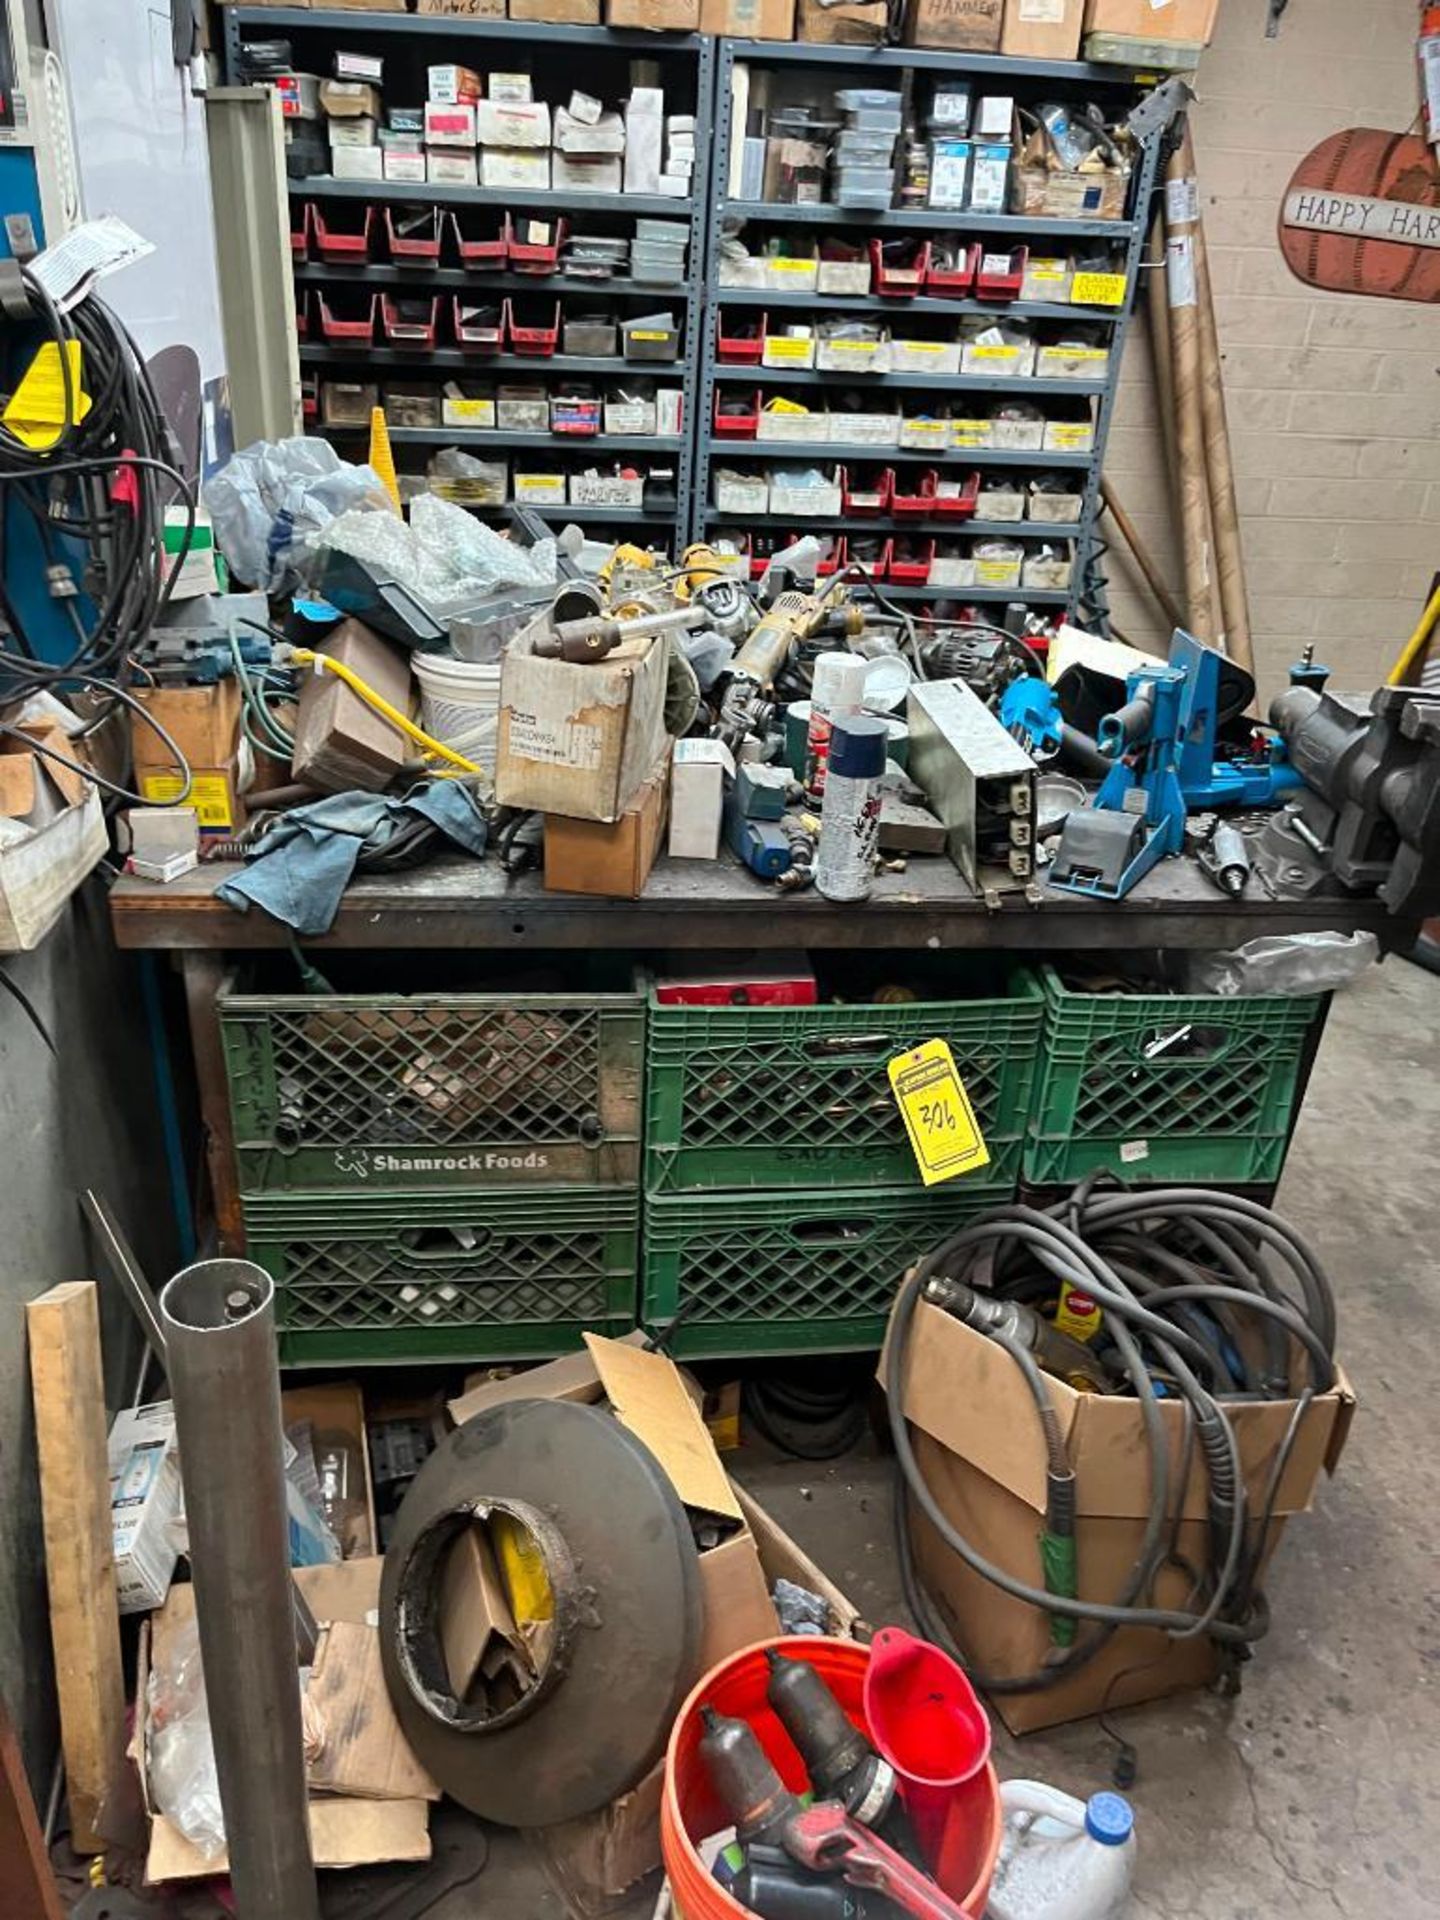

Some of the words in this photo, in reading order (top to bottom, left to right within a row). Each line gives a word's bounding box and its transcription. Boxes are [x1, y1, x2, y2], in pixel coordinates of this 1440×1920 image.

[1296, 195, 1375, 231] HAPPY
[918, 1099, 957, 1134] 306
[373, 1154, 483, 1172] Shamrock
[485, 1152, 549, 1169] Foods
